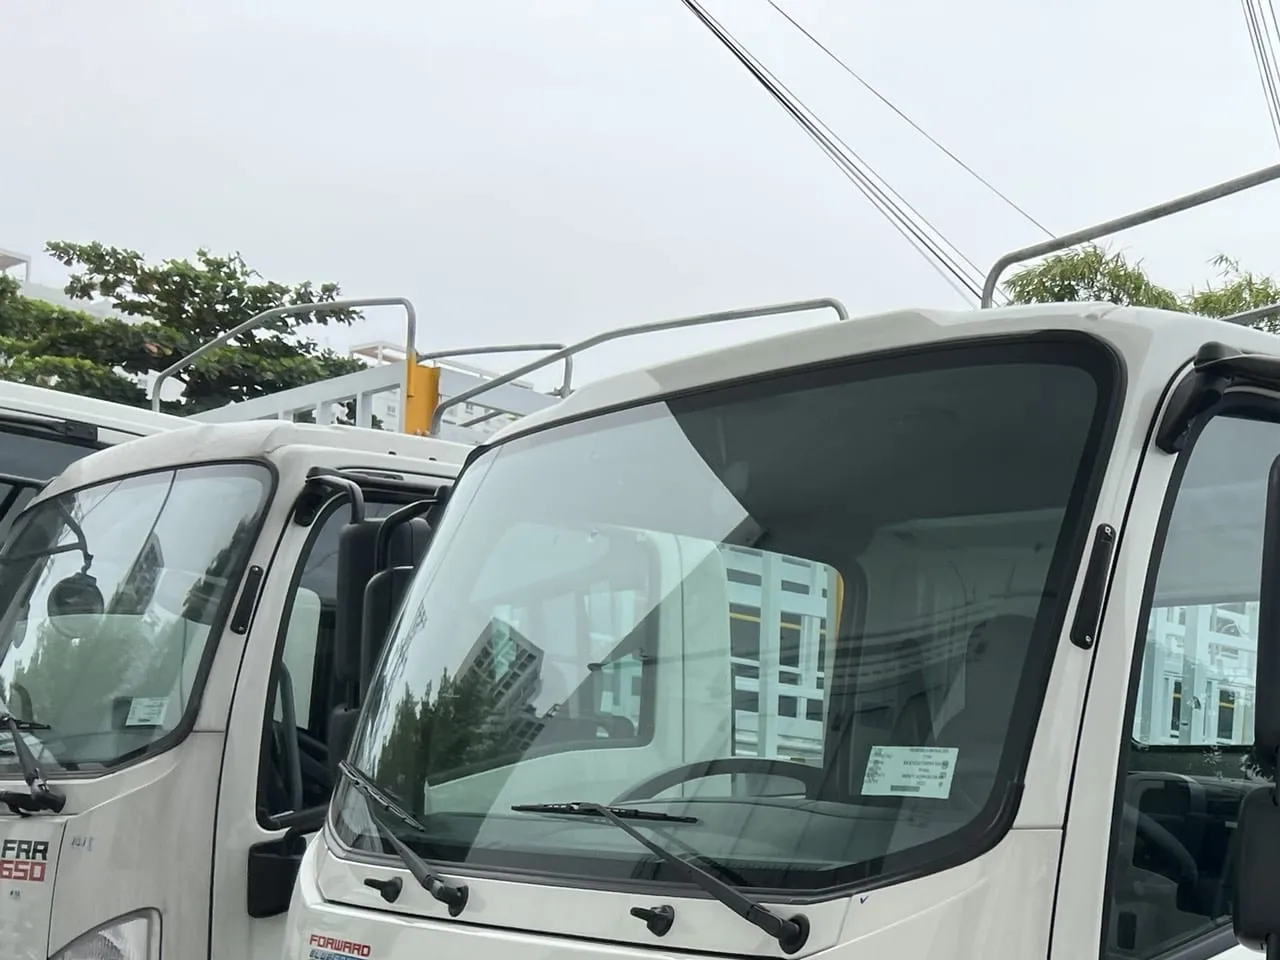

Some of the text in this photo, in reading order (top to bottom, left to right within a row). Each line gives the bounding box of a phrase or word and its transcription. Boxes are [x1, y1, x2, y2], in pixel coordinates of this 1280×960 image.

[1, 839, 49, 860] FRR
[0, 860, 46, 882] 650
[309, 934, 371, 957] FORWARD
